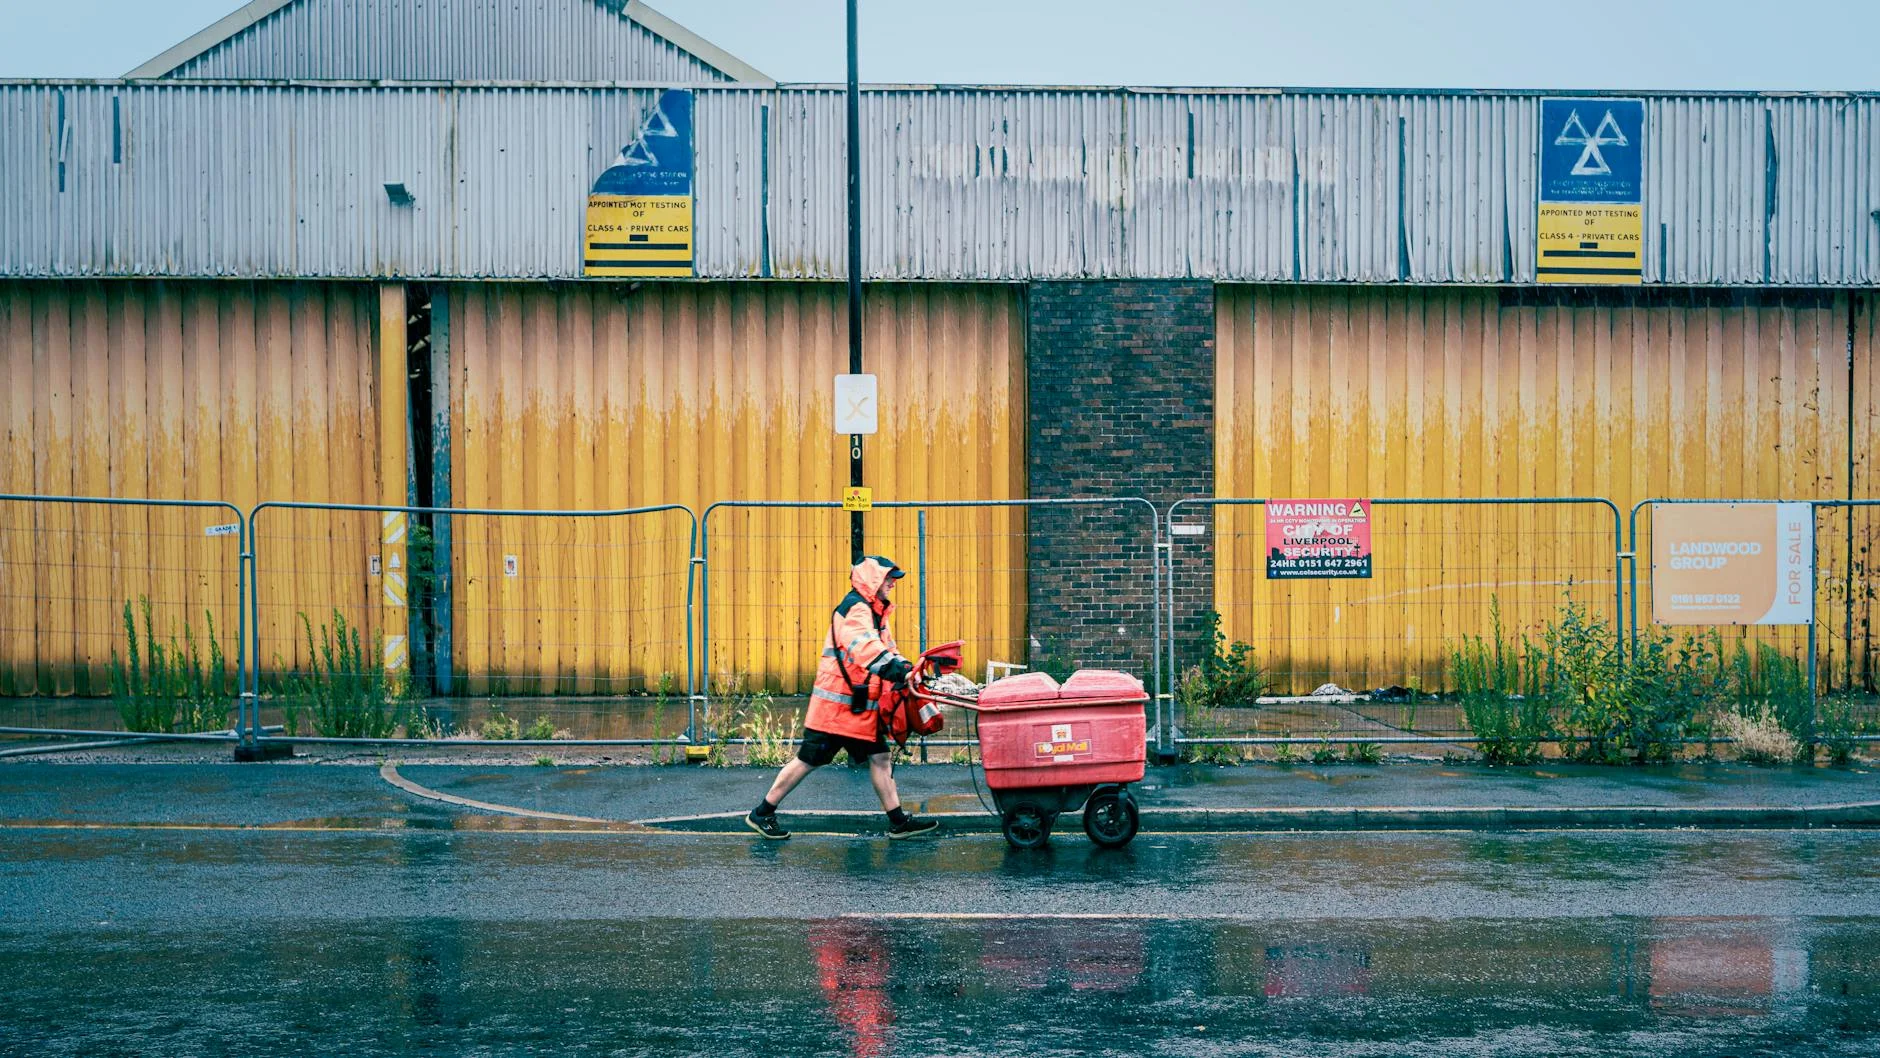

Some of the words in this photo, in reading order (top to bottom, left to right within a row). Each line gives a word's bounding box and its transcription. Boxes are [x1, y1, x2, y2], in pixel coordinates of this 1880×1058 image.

[630, 201, 647, 209] MOT
[1584, 218, 1596, 226] OF
[587, 224, 614, 232] CLASS
[1617, 233, 1640, 241] CARS
[1268, 503, 1347, 516] WARNING
[1283, 537, 1353, 545] LIVERPOOL
[1788, 521, 1801, 565] SALE
[1284, 547, 1352, 557] SECURITY
[1669, 542, 1761, 555] LANDWOOD
[1270, 560, 1297, 568] 24HR
[1298, 560, 1322, 568] 0151
[1344, 559, 1368, 567] 2961
[1670, 557, 1728, 569] GROUP
[1788, 570, 1801, 605] FOR
